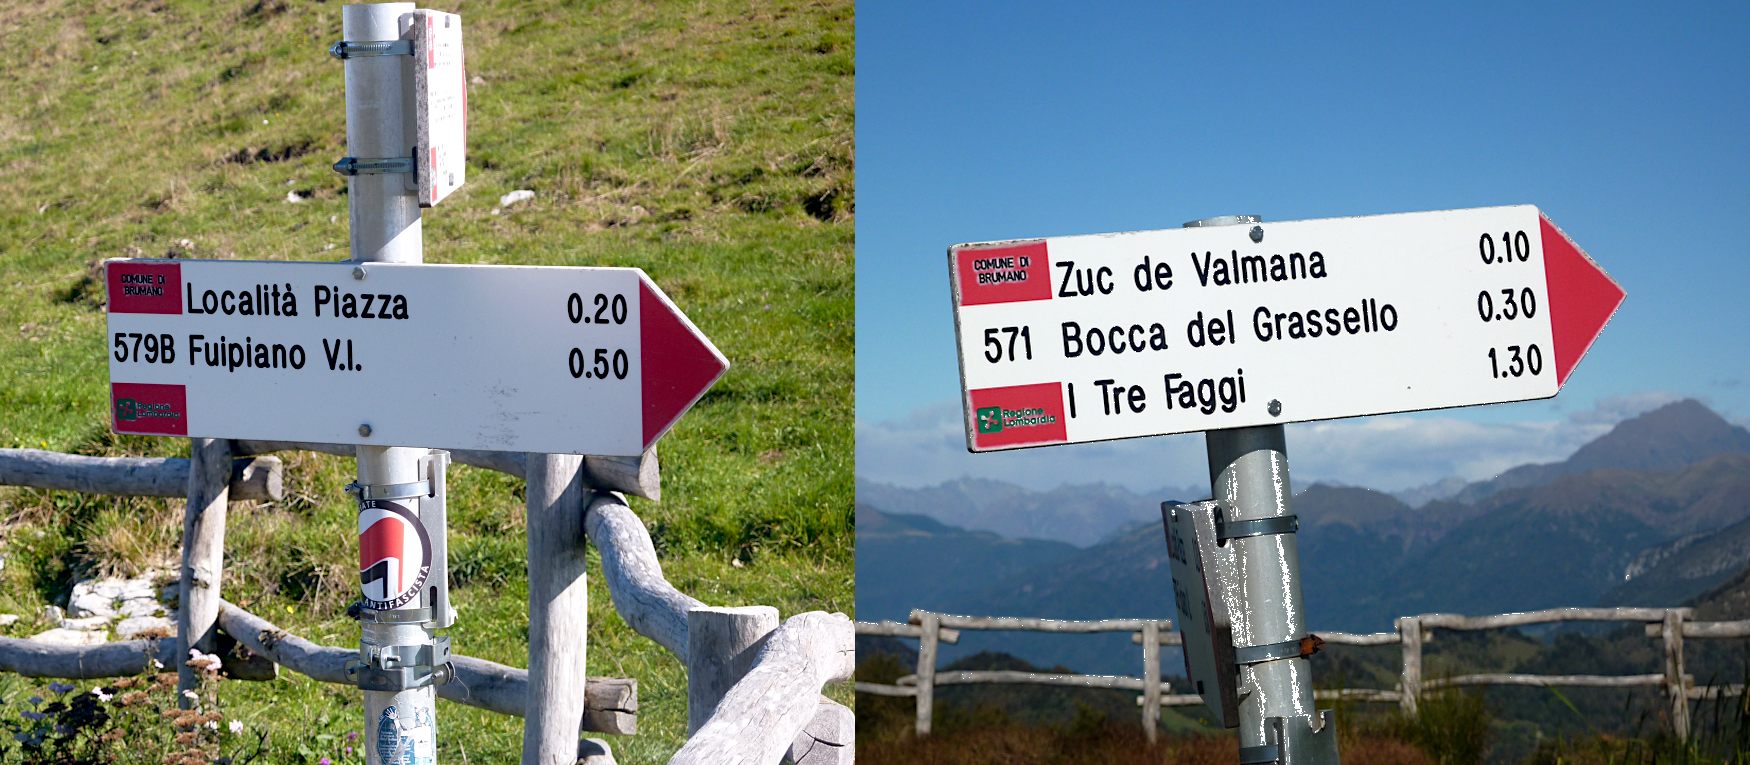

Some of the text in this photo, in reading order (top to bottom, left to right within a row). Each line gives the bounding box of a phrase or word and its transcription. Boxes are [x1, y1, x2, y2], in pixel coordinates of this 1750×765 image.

[974, 256, 1029, 271] COMUNE DI
[1479, 230, 1530, 264] 0.10
[121, 274, 153, 284] COMUNE
[979, 270, 1027, 284] BRUMANO
[1056, 250, 1328, 297] Zuc de Valmana
[124, 286, 163, 296] BRUMANO
[187, 282, 409, 319] Località Piazza
[1478, 287, 1536, 322] 0.30
[567, 293, 627, 325] 0.20
[984, 325, 1032, 363] 571
[1061, 298, 1398, 358] Bocca del Grassello
[114, 332, 176, 364] 579B
[188, 334, 362, 372] Fuipiano V.I.
[569, 347, 628, 380] 0.50
[1488, 344, 1543, 379] 1.30
[1068, 368, 1246, 418] I Tre Faggi
[1003, 408, 1043, 417] Regione
[1004, 415, 1056, 427] Lombardia
[364, 565, 430, 609] ANTIFASCISTA
